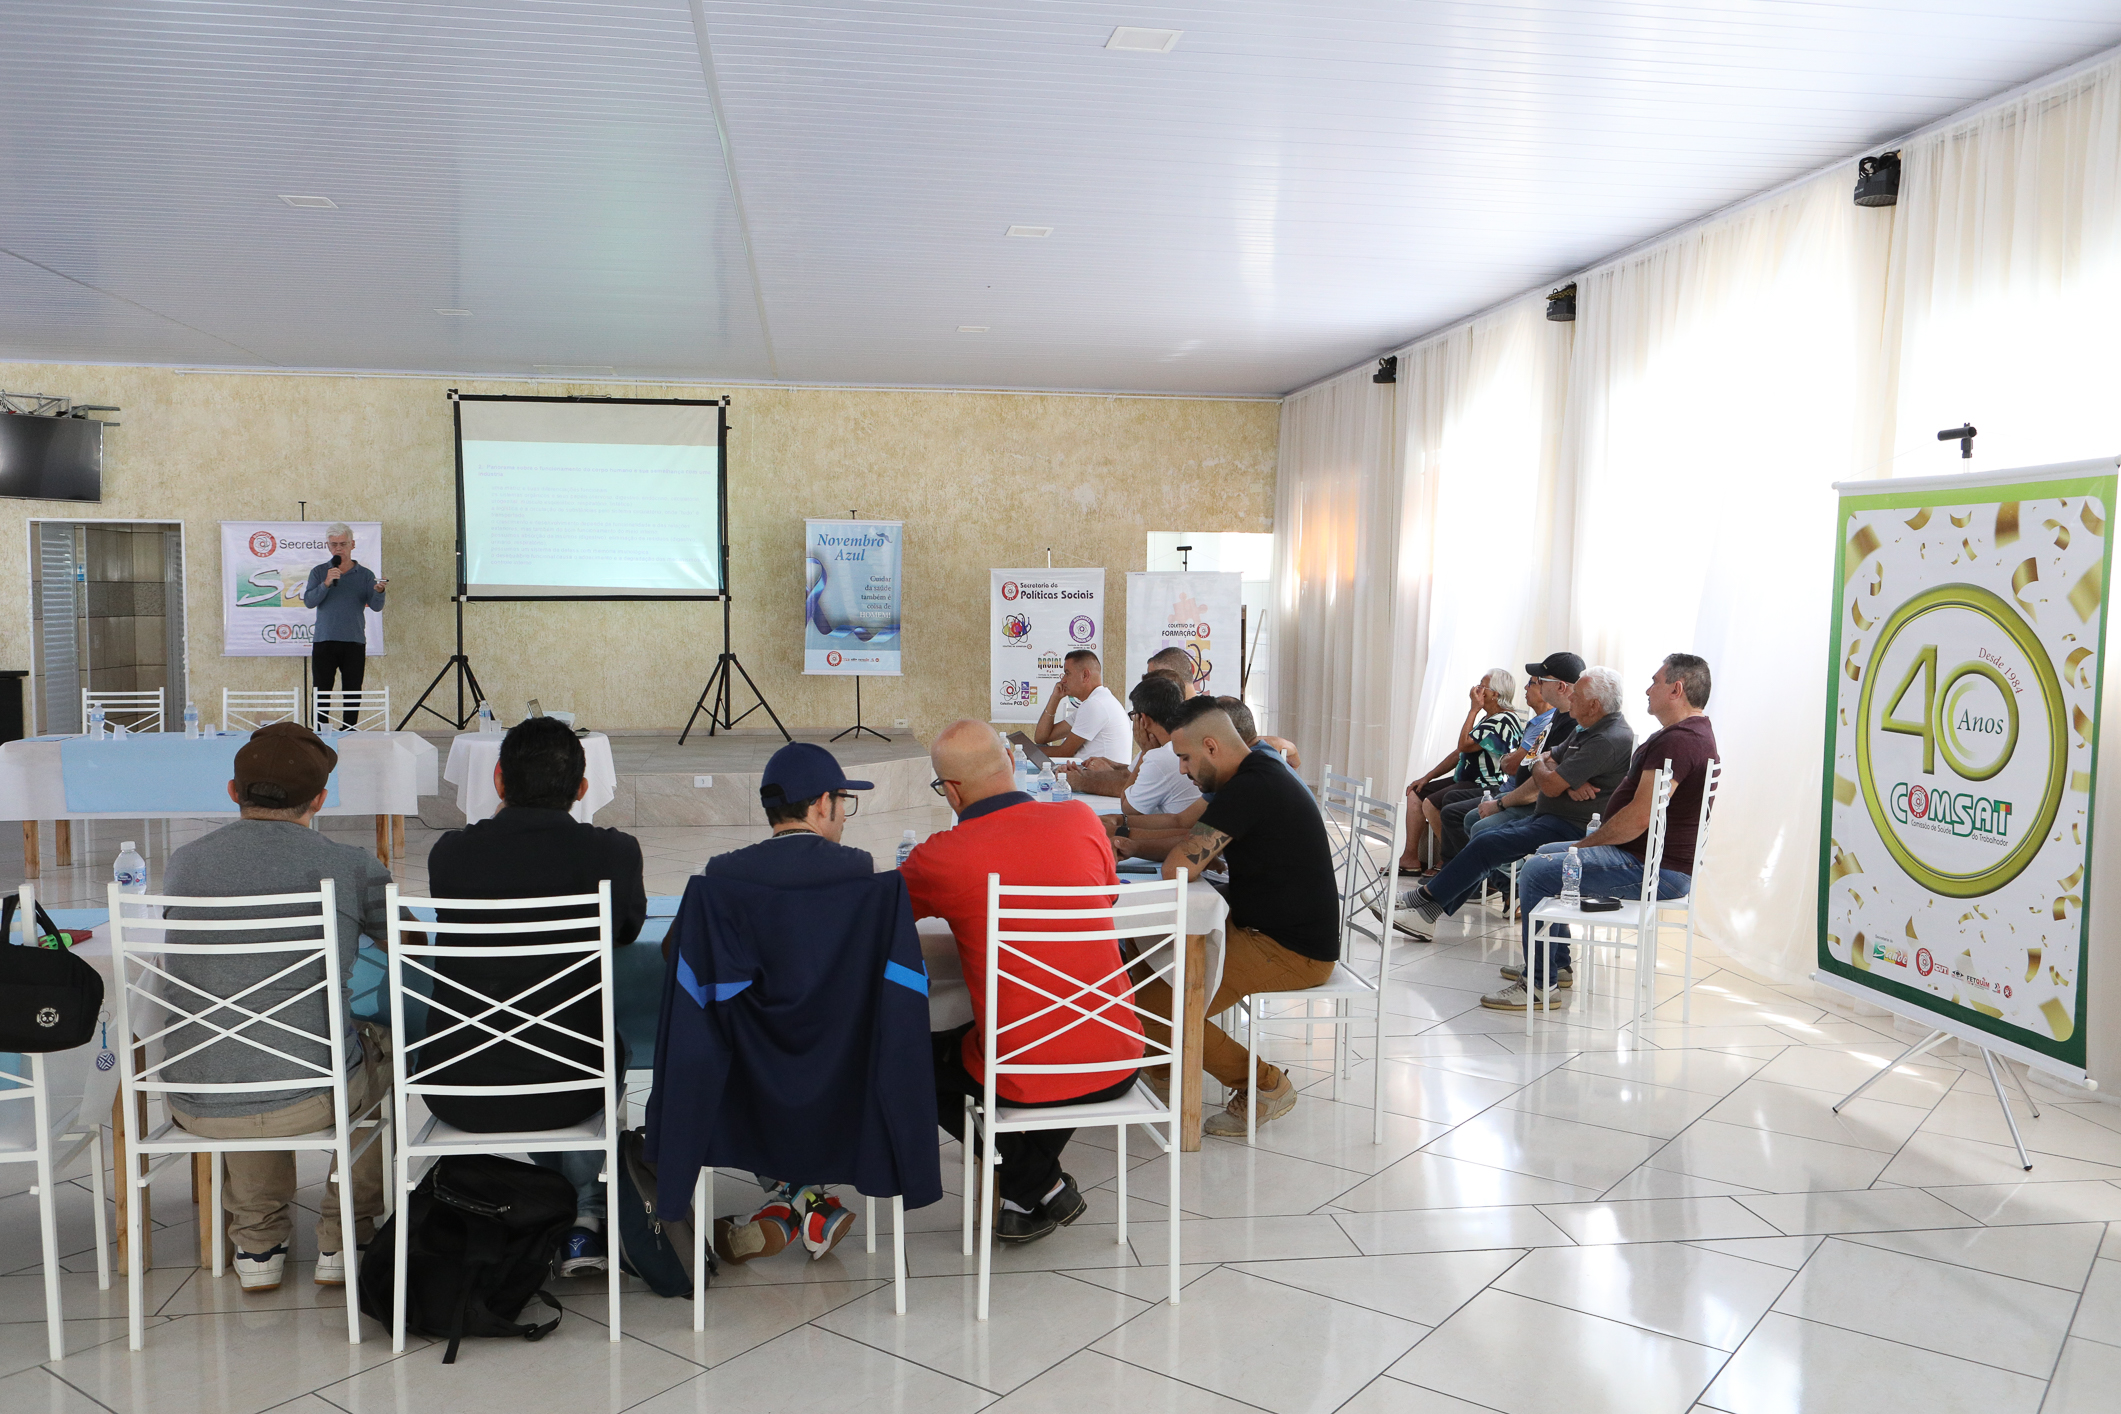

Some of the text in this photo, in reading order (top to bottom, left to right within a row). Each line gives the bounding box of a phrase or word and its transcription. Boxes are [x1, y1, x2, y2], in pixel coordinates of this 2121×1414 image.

[279, 539, 330, 549] Secretar
[817, 534, 884, 548] Novembro
[835, 549, 866, 562] Azul
[870, 575, 892, 583] Cuidar
[873, 584, 892, 592] saúde
[1020, 590, 1094, 600] Políticas Sociais
[866, 602, 882, 610] coisa
[859, 611, 891, 619] HOMEM!
[1161, 629, 1197, 639] FORMAÇÃO
[1038, 657, 1064, 670] RACIAL
[1979, 647, 2024, 694] Desde 1984
[1881, 644, 2019, 782] 40
[1956, 706, 2004, 736] Anos
[1890, 782, 2012, 838] COMSAT
[1911, 819, 1930, 831] Comissão
[1938, 826, 1952, 835] Saúde
[1971, 832, 2009, 848] do Trabalhador
